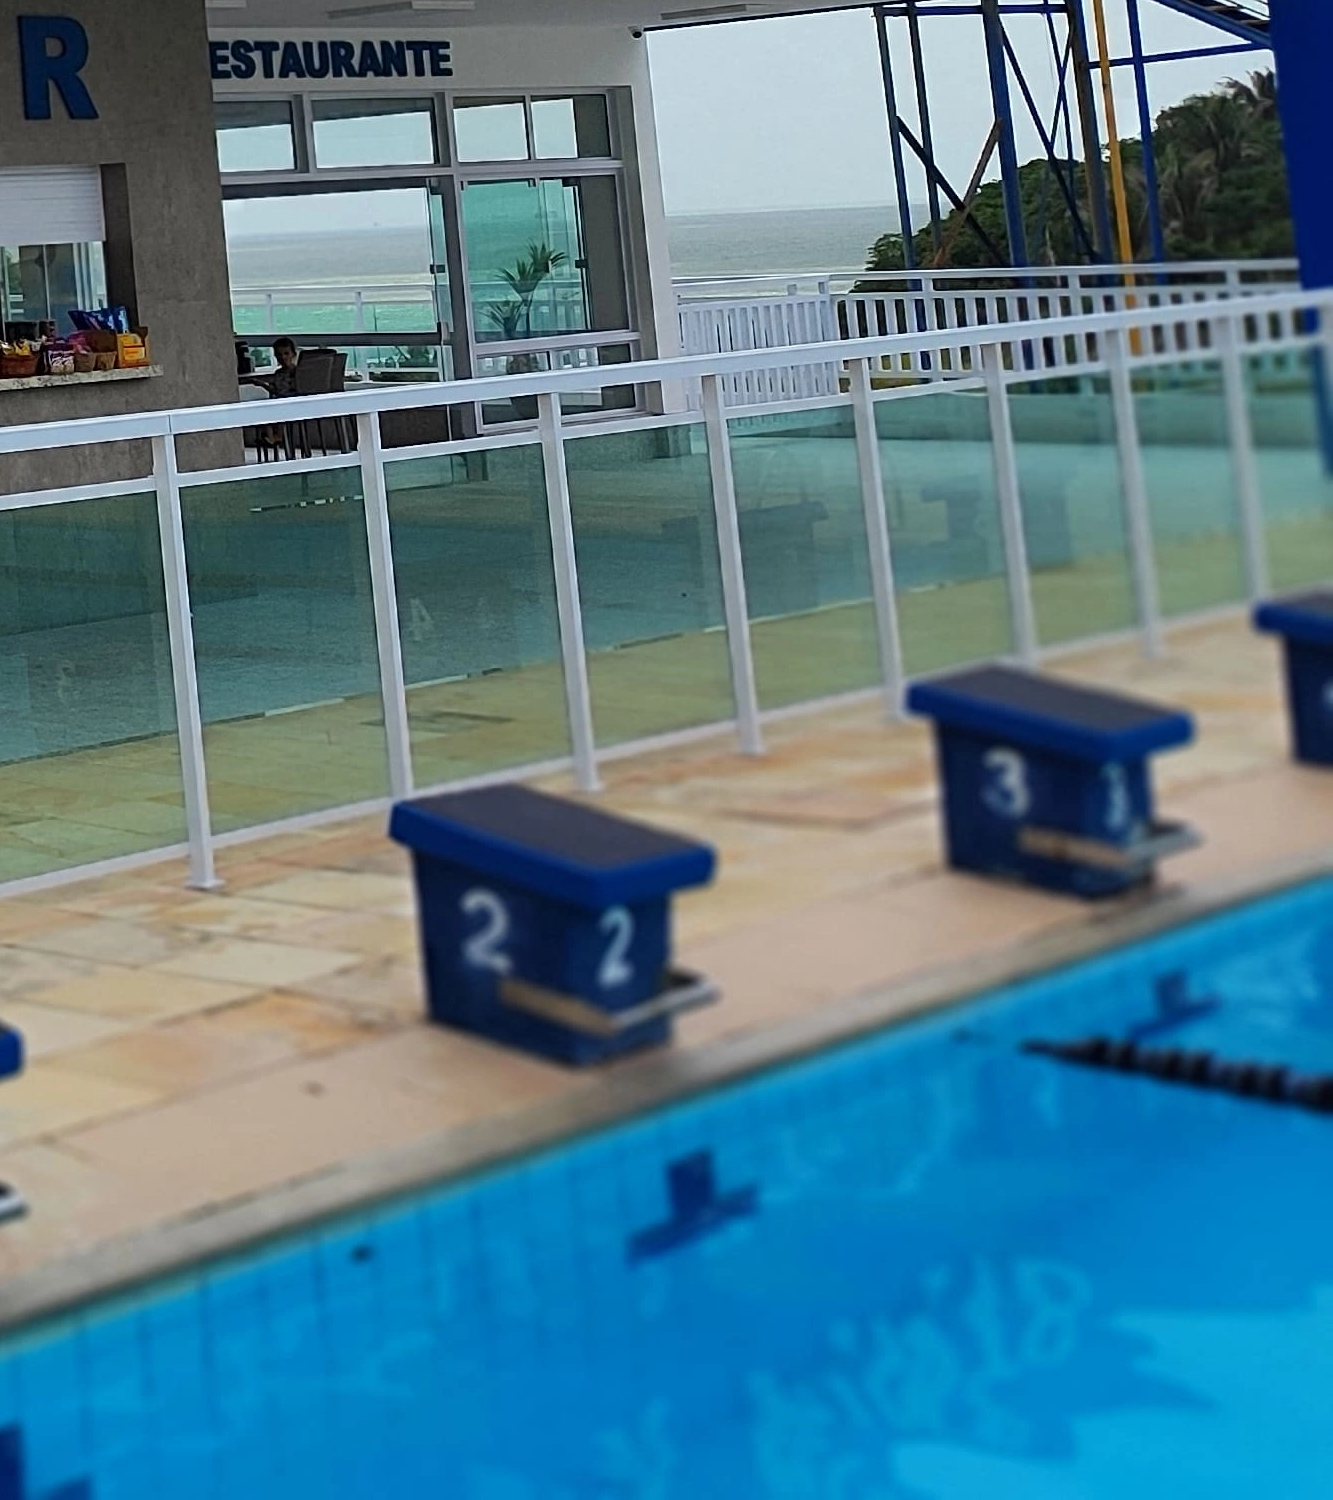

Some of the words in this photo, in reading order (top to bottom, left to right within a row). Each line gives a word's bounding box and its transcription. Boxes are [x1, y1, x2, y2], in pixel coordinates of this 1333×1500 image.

[208, 39, 453, 79] ESTAURANTE
[981, 746, 1029, 819] 3
[460, 887, 512, 974] 2
[598, 904, 634, 988] 2
